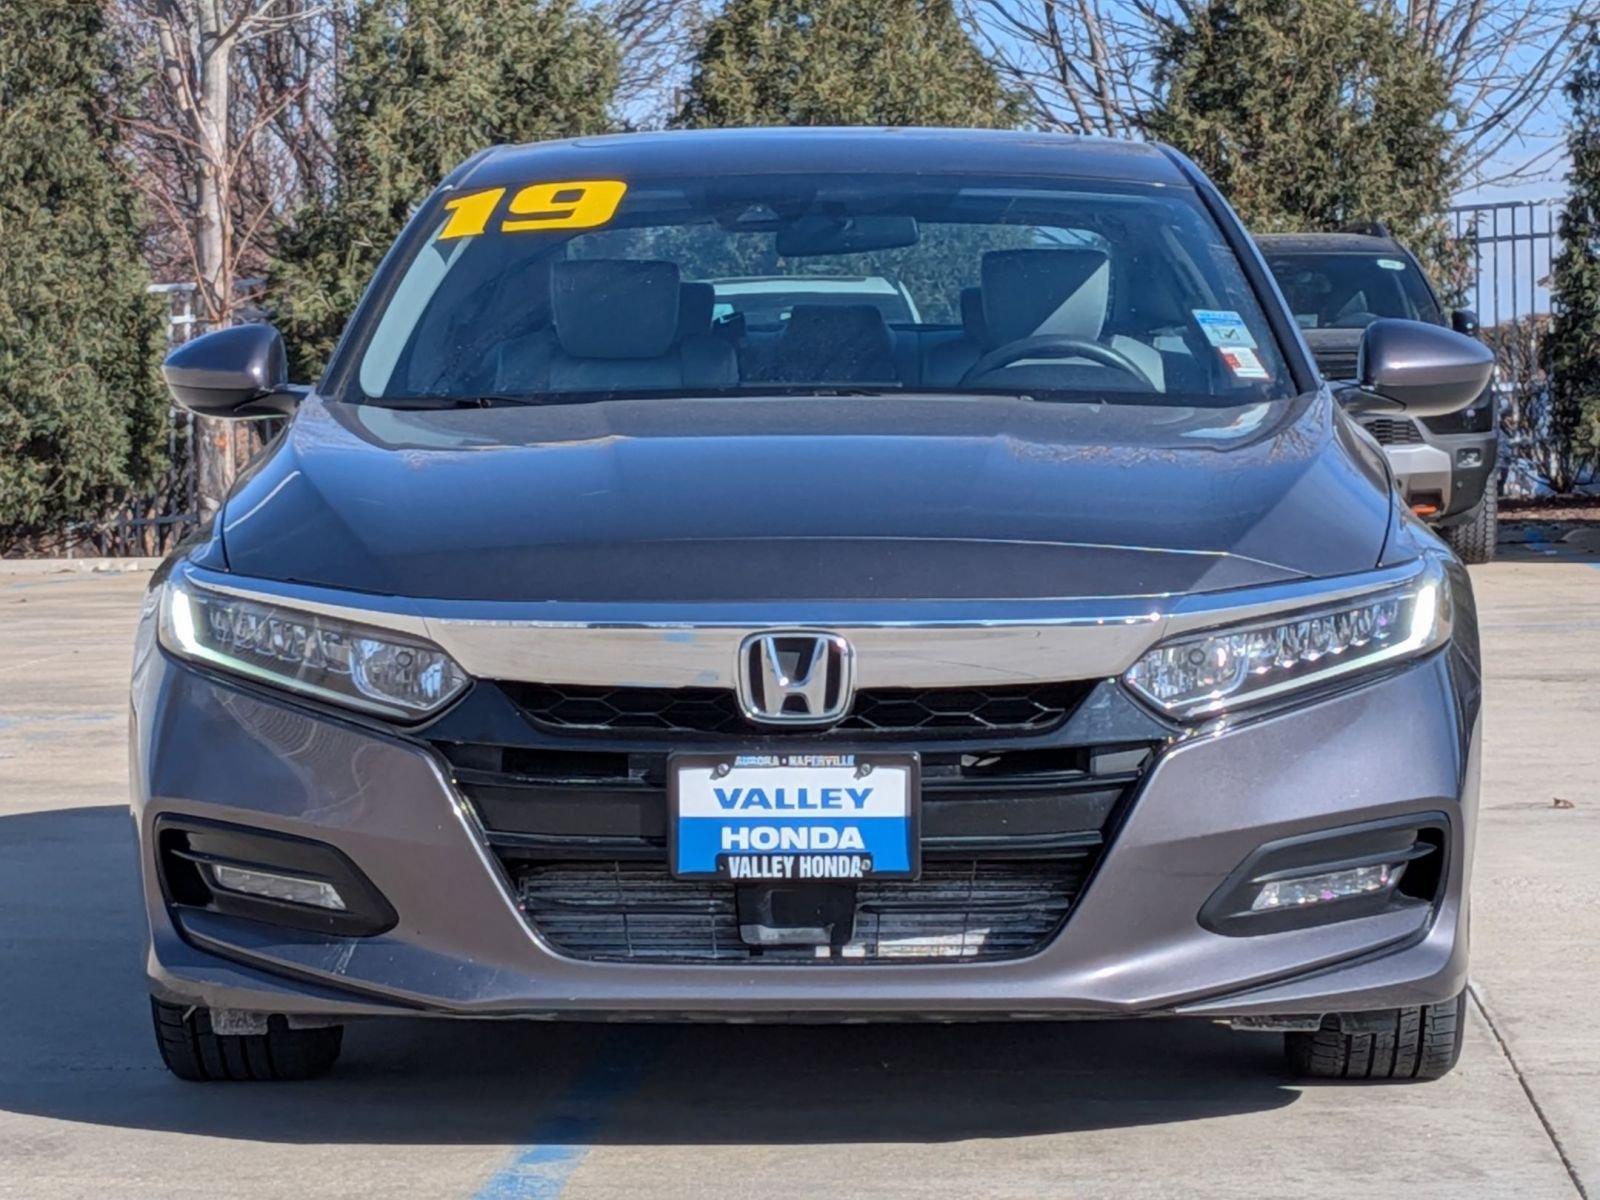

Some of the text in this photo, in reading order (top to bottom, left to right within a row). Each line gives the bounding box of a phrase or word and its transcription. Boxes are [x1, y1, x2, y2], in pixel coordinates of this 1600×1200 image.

[437, 180, 628, 240] 19
[713, 787, 874, 810] VALLEY
[721, 826, 866, 850] HONDA
[728, 855, 864, 878] VALLEY HONDA
